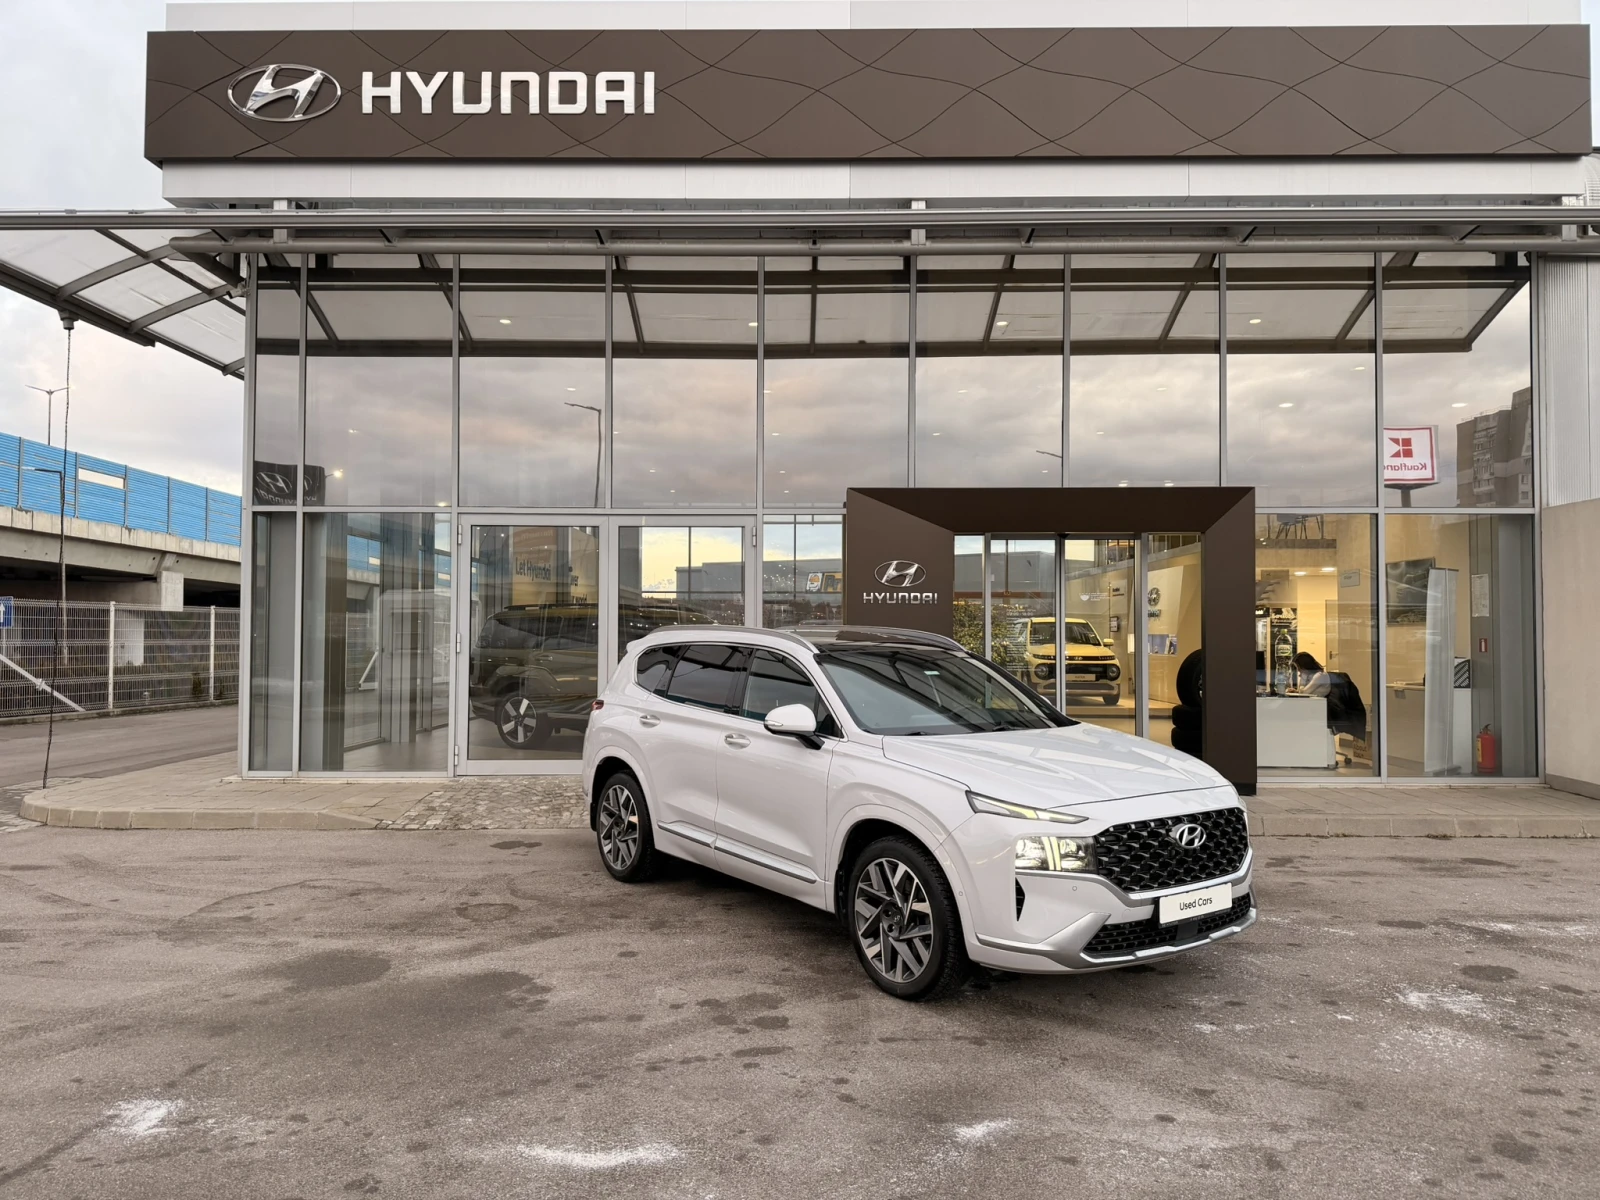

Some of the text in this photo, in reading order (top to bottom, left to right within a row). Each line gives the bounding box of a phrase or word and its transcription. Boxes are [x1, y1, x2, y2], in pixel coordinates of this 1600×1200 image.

[362, 71, 655, 114] HYUNDAI
[515, 556, 526, 576] Let
[527, 559, 551, 581] Hyundai
[863, 592, 937, 604] HYUNDAI
[1179, 897, 1213, 911] Used Cars
